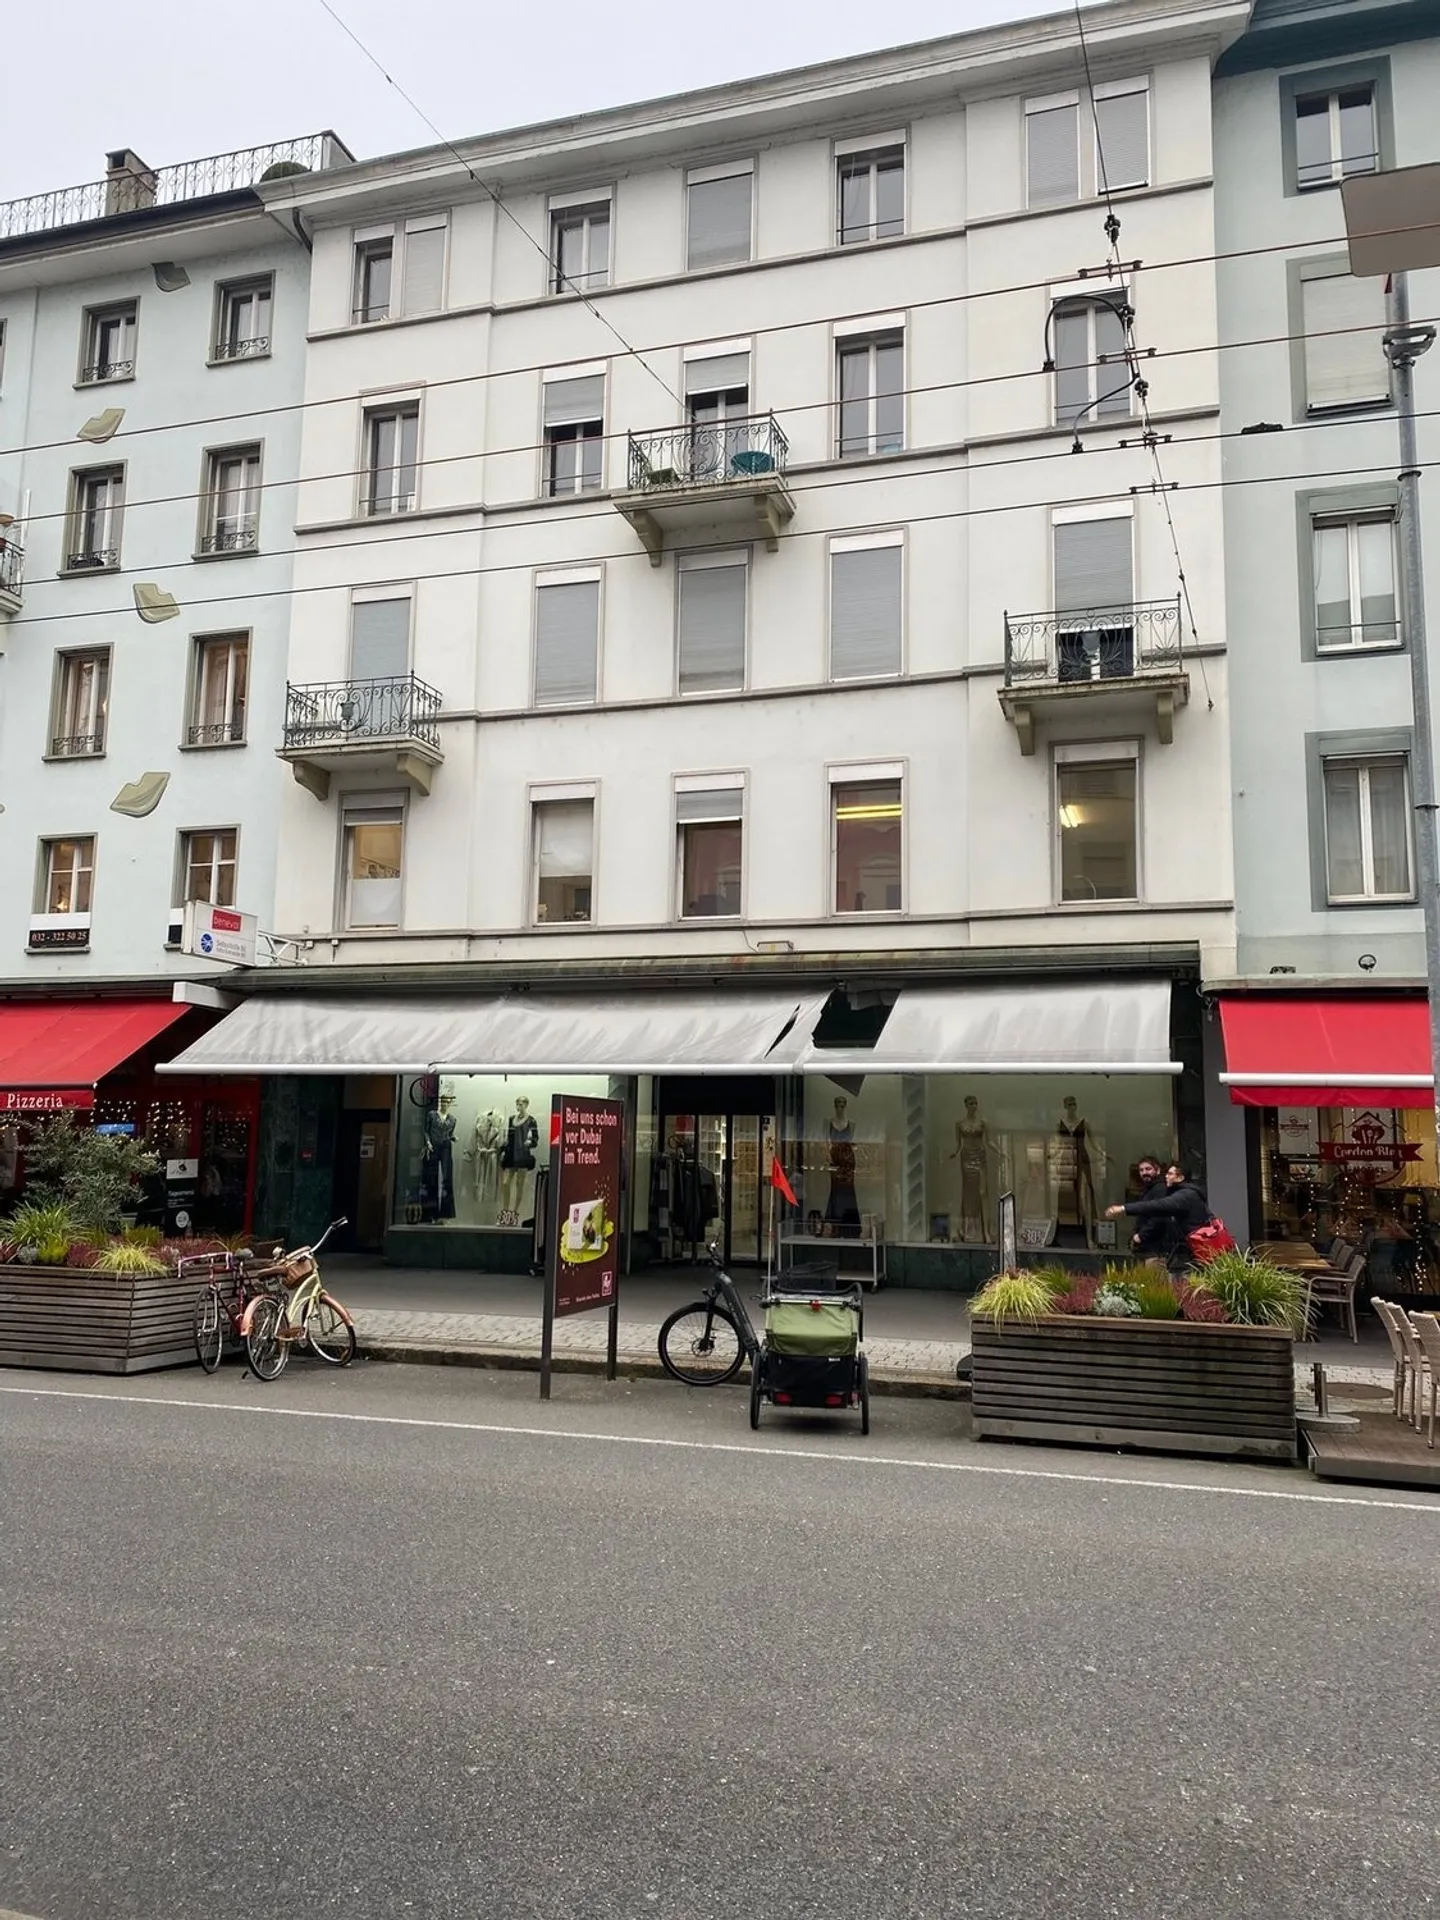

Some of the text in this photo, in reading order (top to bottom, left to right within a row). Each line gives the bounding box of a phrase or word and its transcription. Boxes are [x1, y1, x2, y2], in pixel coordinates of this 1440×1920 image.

[6, 1093, 64, 1109] Pizzeria
[565, 1107, 617, 1126] Bei uns schon
[565, 1128, 602, 1145] vor Dubai
[564, 1147, 600, 1164] im Trend.
[1333, 1145, 1374, 1158] Cordon
